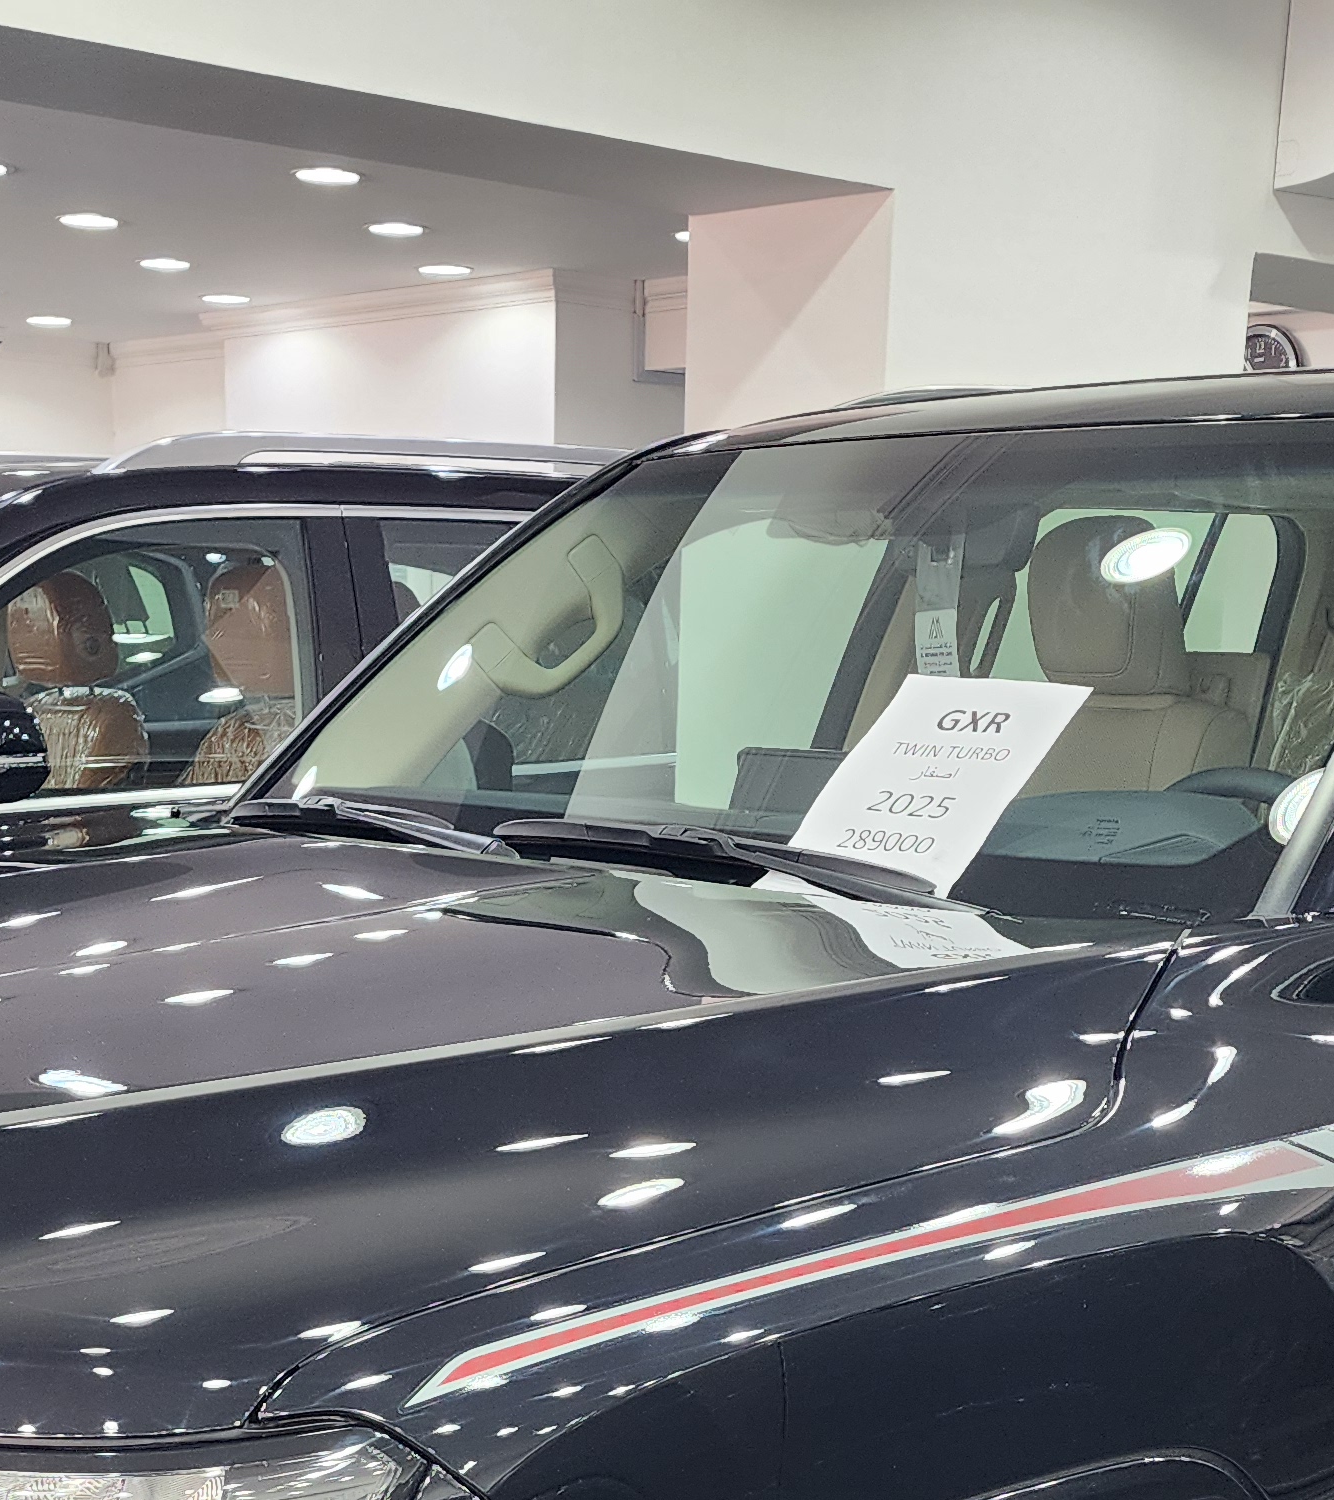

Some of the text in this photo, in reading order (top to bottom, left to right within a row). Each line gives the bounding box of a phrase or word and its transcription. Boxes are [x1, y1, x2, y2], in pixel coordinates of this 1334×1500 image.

[936, 709, 1011, 734] GXR
[892, 741, 1011, 762] TWIN TURBO
[908, 765, 960, 781] اصفار
[865, 790, 957, 819] 2025
[835, 828, 936, 854] 289000
